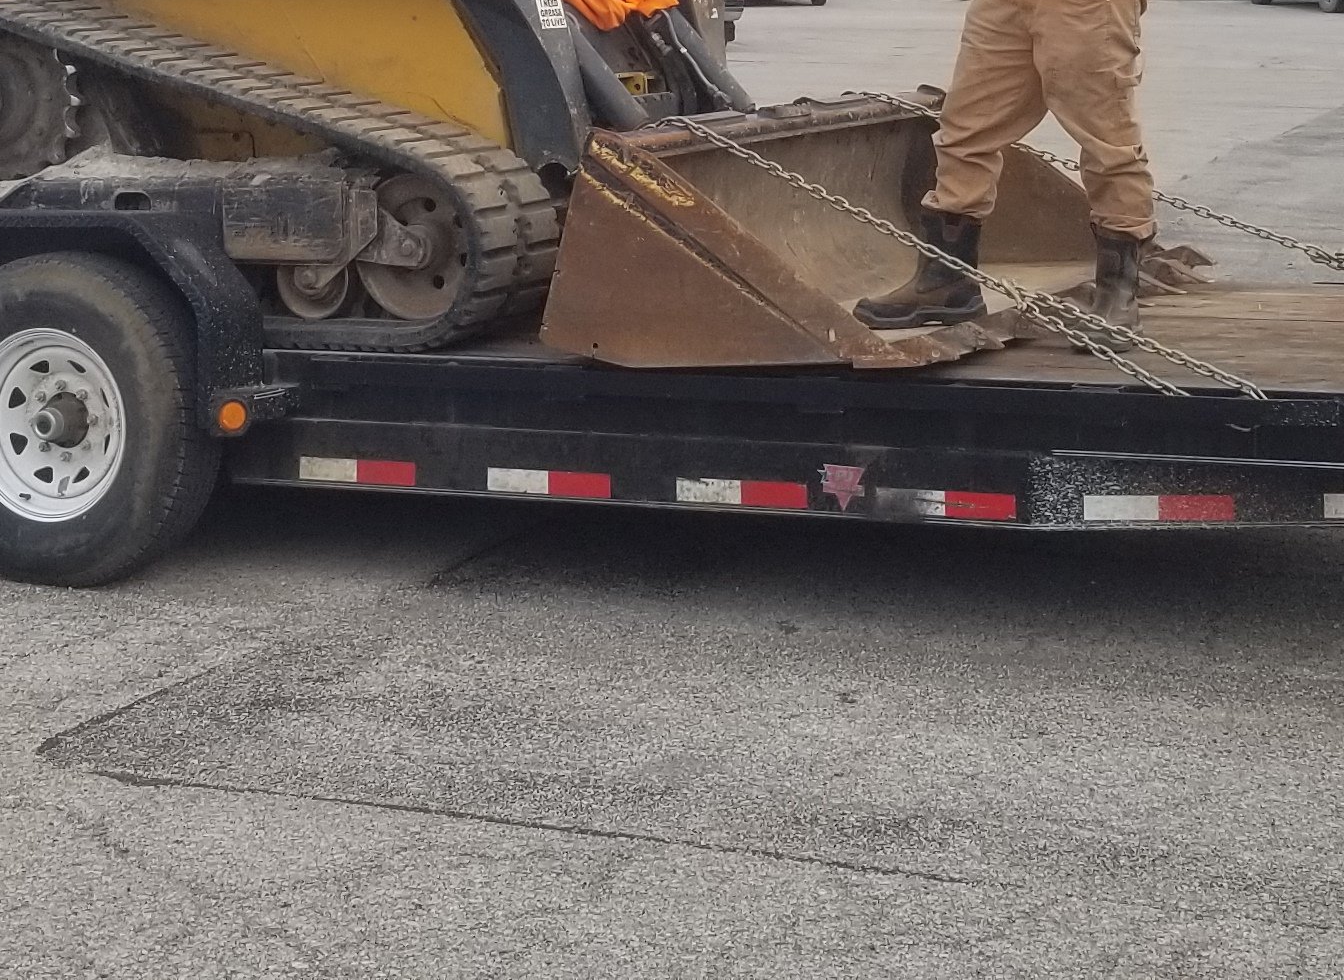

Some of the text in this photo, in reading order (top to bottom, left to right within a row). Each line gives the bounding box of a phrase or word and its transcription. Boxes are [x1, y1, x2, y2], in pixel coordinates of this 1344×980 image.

[544, 0, 559, 8] NEED
[540, 8, 563, 17] GREASE
[542, 18, 551, 27] TO
